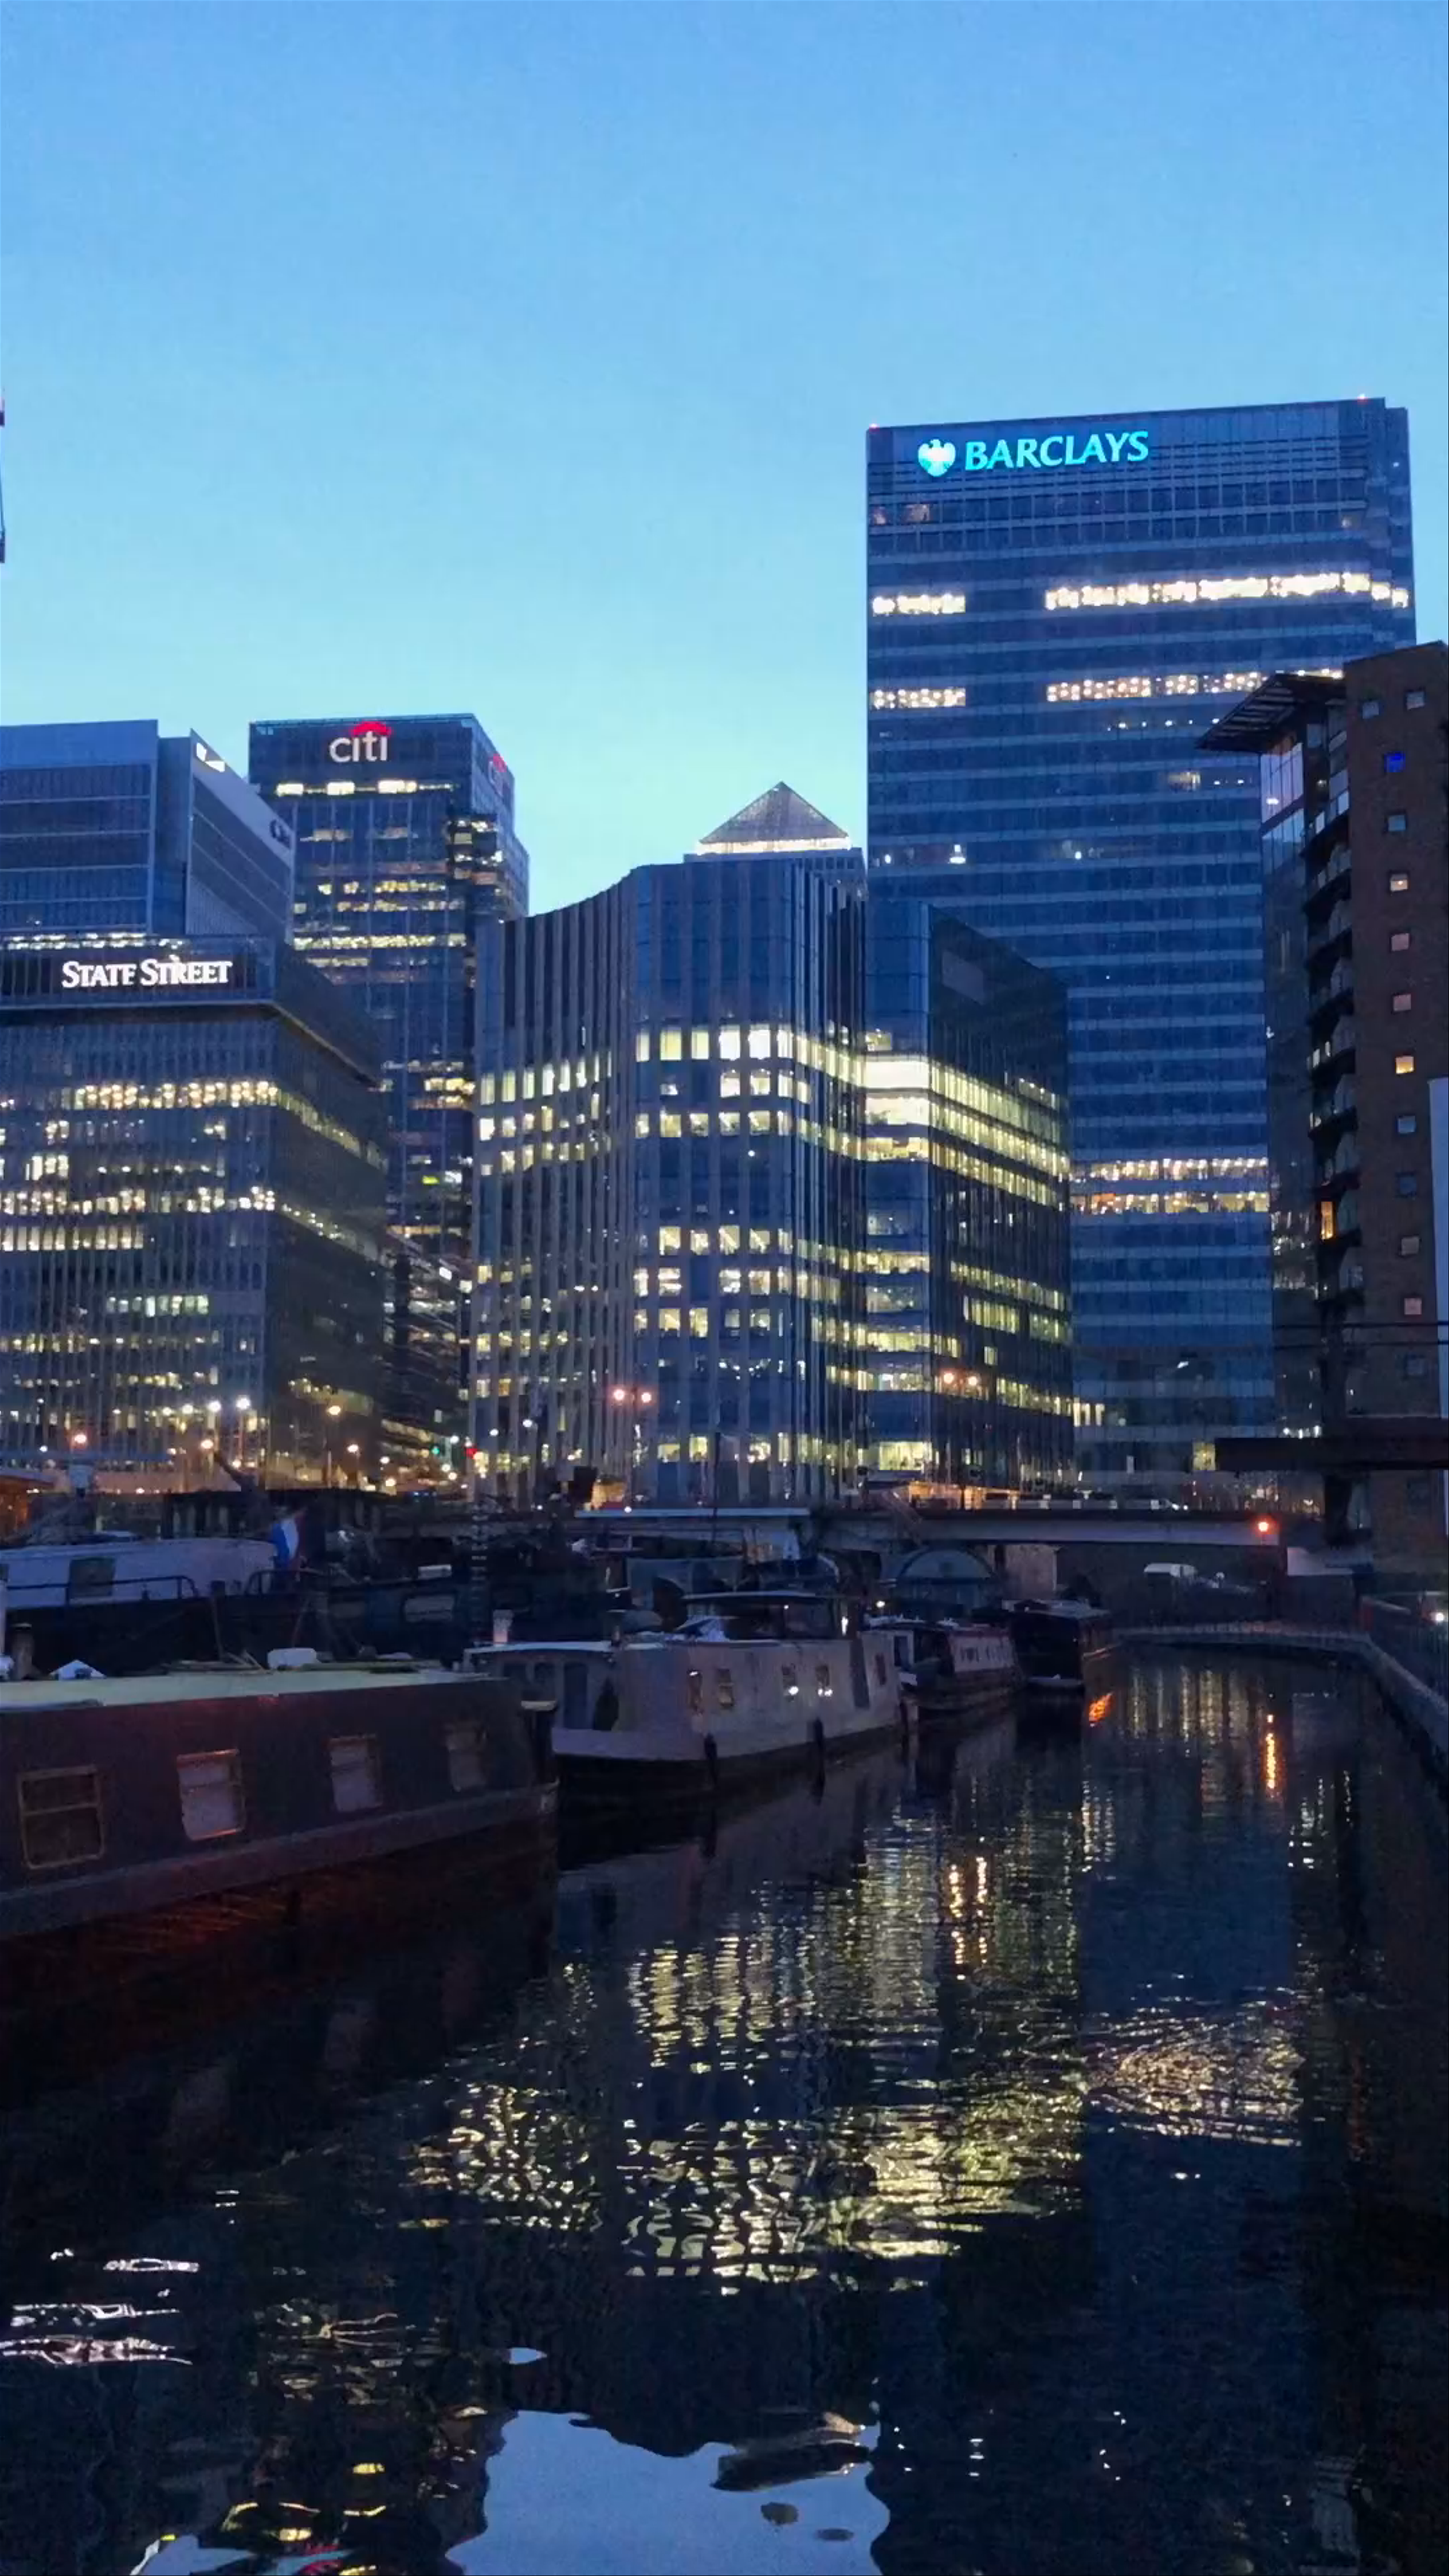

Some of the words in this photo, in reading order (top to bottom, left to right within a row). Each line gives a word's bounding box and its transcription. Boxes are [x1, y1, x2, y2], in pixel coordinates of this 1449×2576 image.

[964, 431, 1149, 471] BARCLAYS
[329, 730, 388, 762] citi
[62, 961, 137, 988] STATE
[140, 958, 233, 986] STREET
